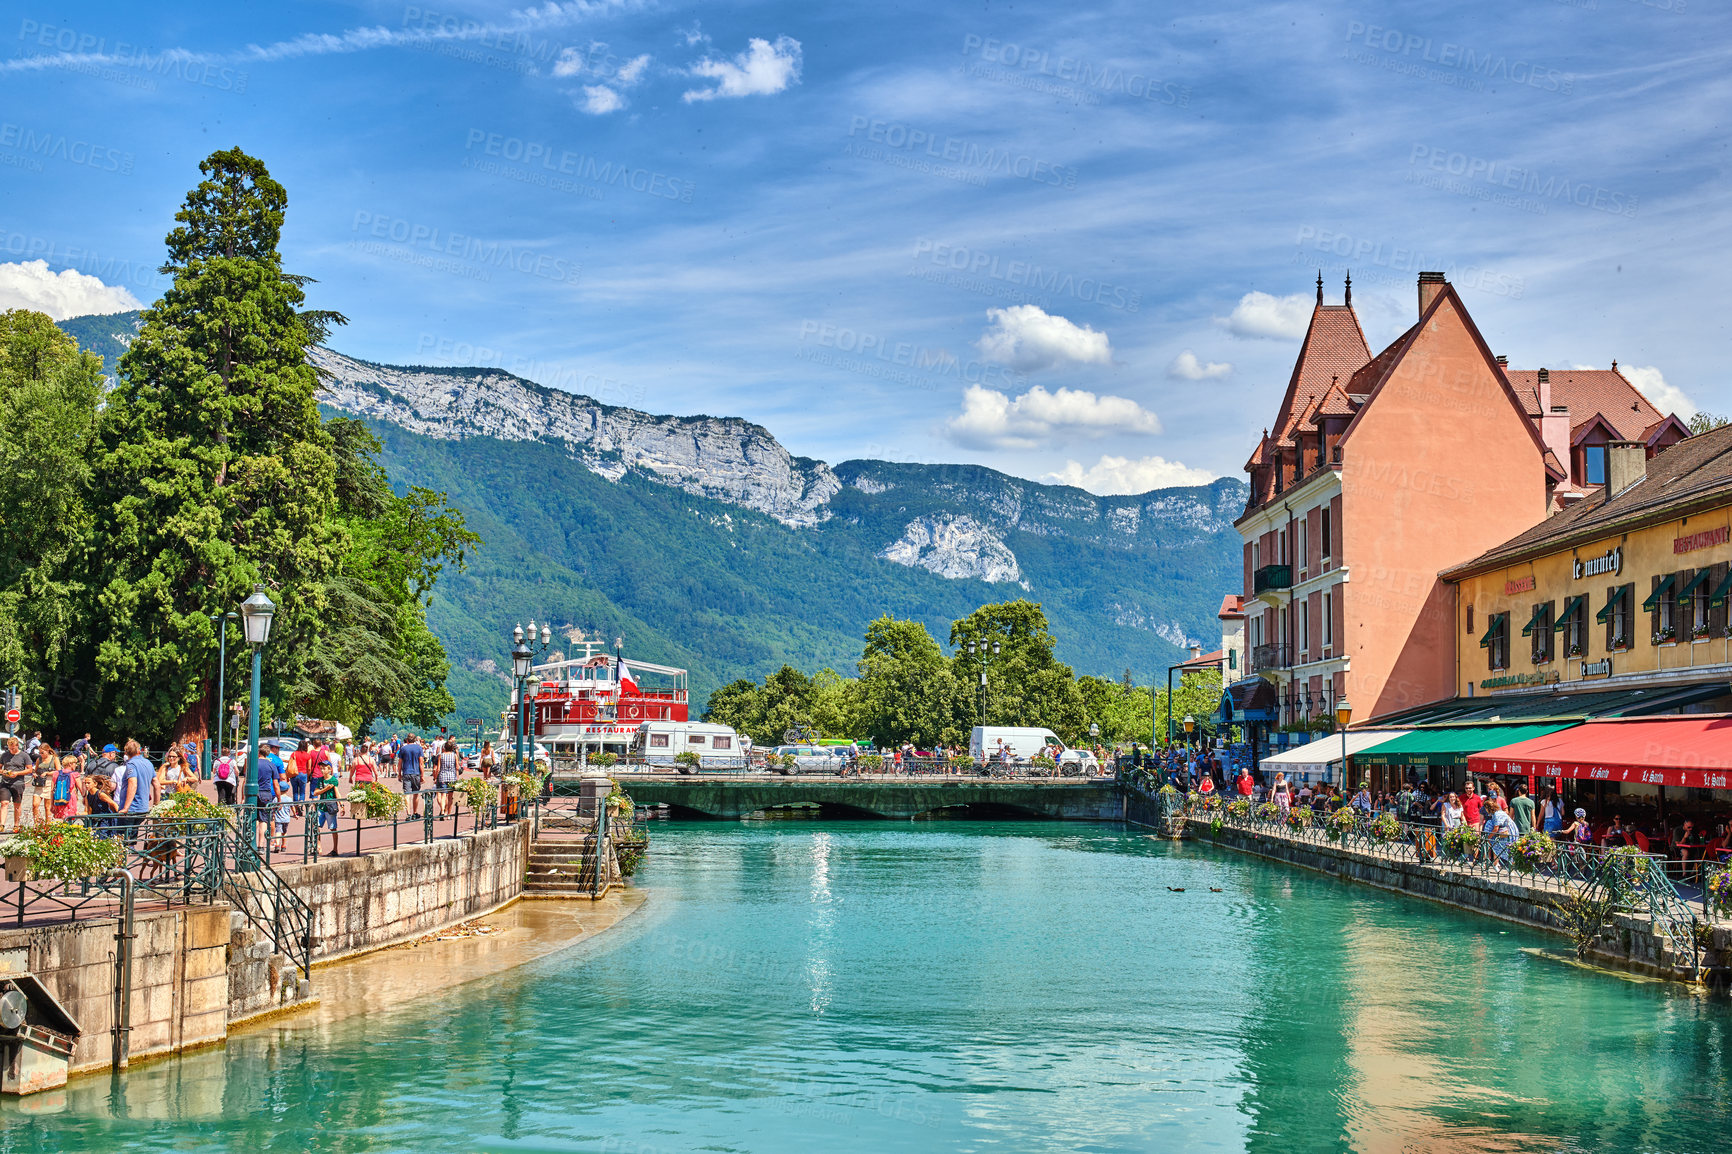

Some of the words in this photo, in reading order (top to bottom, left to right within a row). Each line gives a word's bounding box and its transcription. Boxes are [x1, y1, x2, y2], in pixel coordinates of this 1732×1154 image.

[1674, 526, 1728, 554] RESTAURANT
[1573, 558, 1582, 580] le
[1585, 546, 1622, 577] munich
[1587, 658, 1612, 678] munich
[1642, 770, 1648, 782] Le
[1704, 772, 1710, 786] Le
